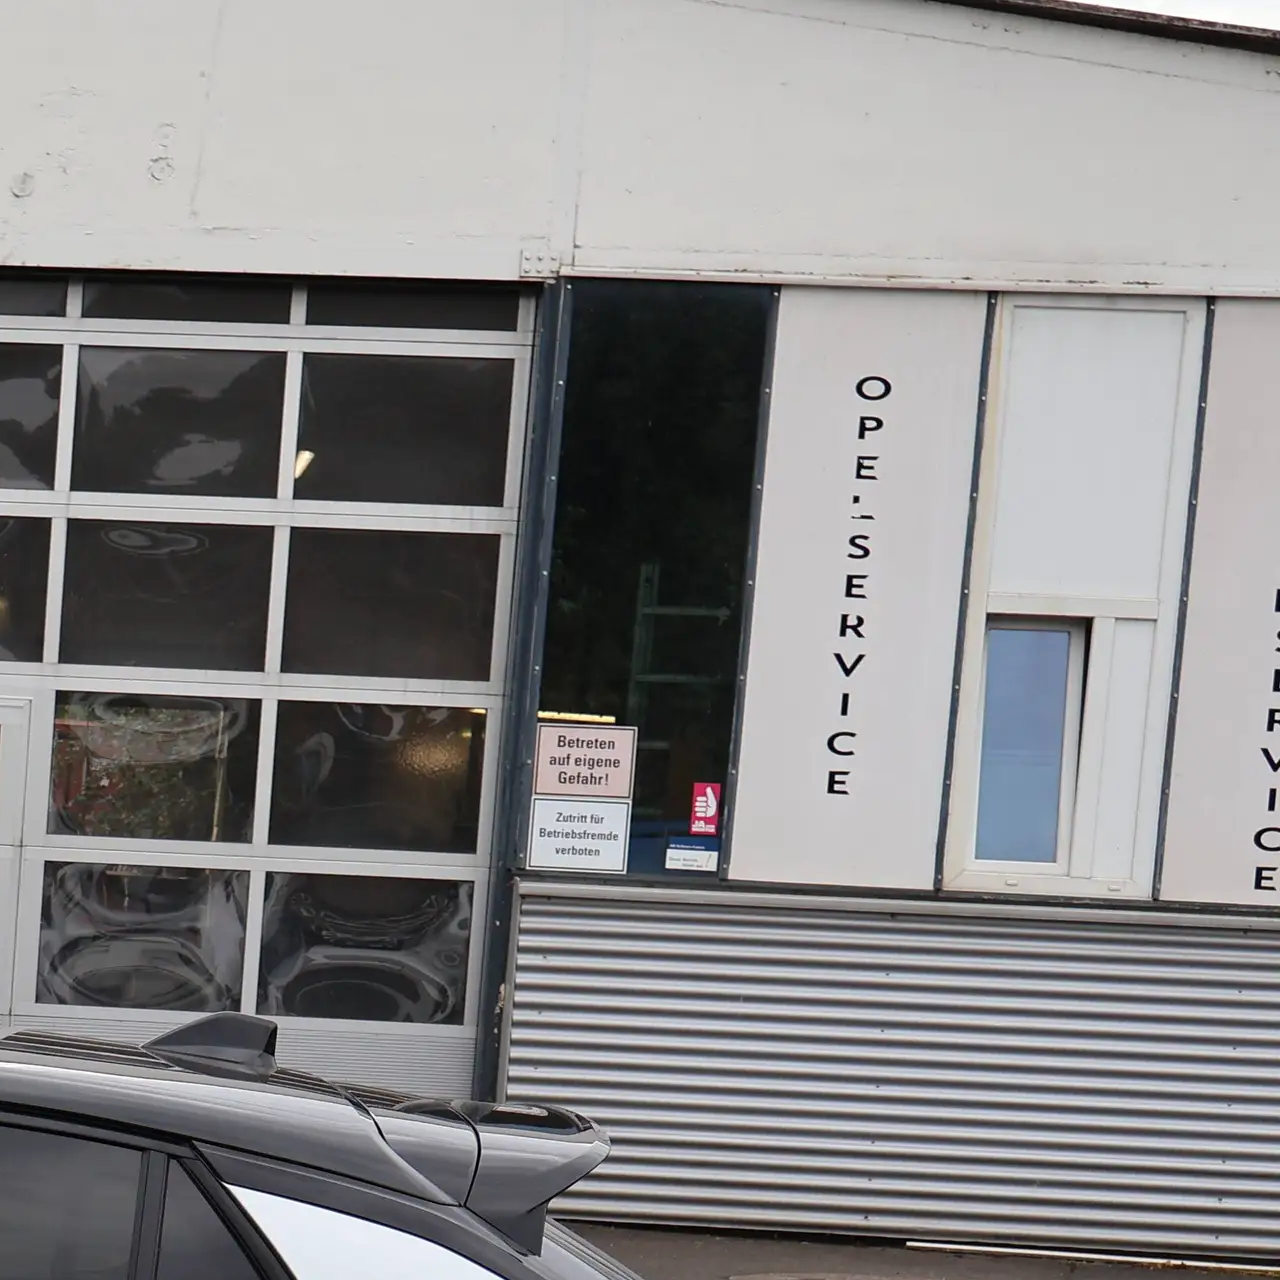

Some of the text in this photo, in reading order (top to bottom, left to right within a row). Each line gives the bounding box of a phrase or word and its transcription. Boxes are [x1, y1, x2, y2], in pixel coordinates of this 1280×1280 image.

[557, 735, 616, 750] Betreten
[549, 753, 621, 770] auf eigene
[558, 771, 609, 786] Gefahr!
[555, 812, 605, 824] Zutritt für
[539, 827, 619, 841] Betriebsfremde
[555, 845, 601, 857] verboten
